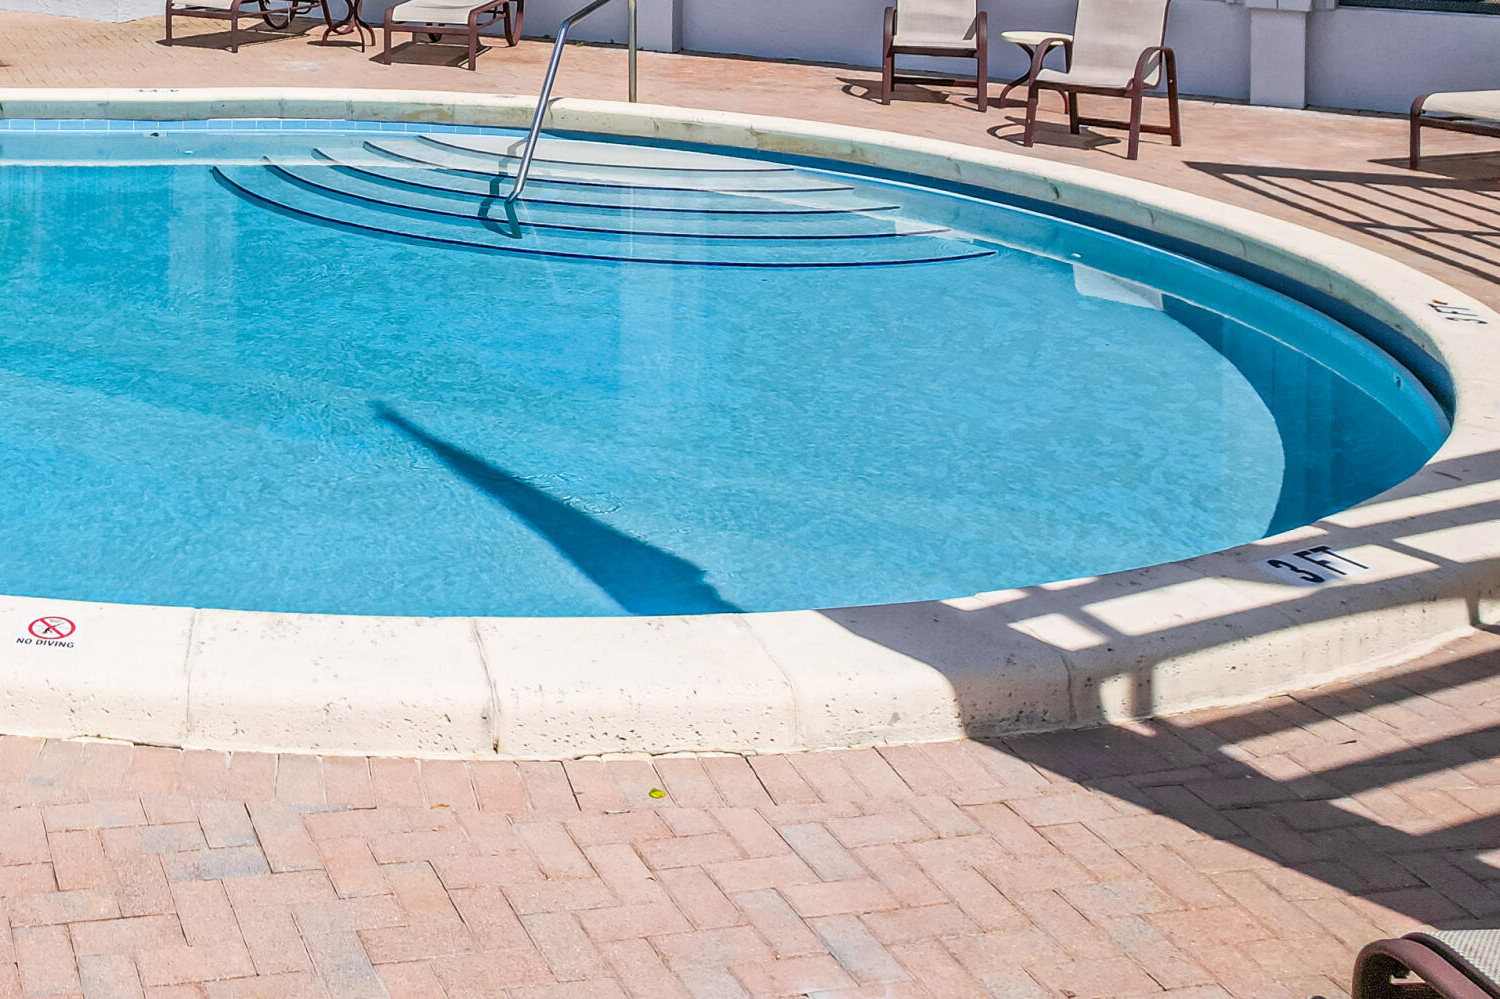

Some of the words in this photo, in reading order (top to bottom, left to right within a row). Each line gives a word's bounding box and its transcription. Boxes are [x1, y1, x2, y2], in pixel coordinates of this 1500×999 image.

[1267, 559, 1326, 583] 3
[1293, 545, 1369, 576] FT
[16, 637, 33, 645] NO
[35, 639, 75, 648] DIVING
